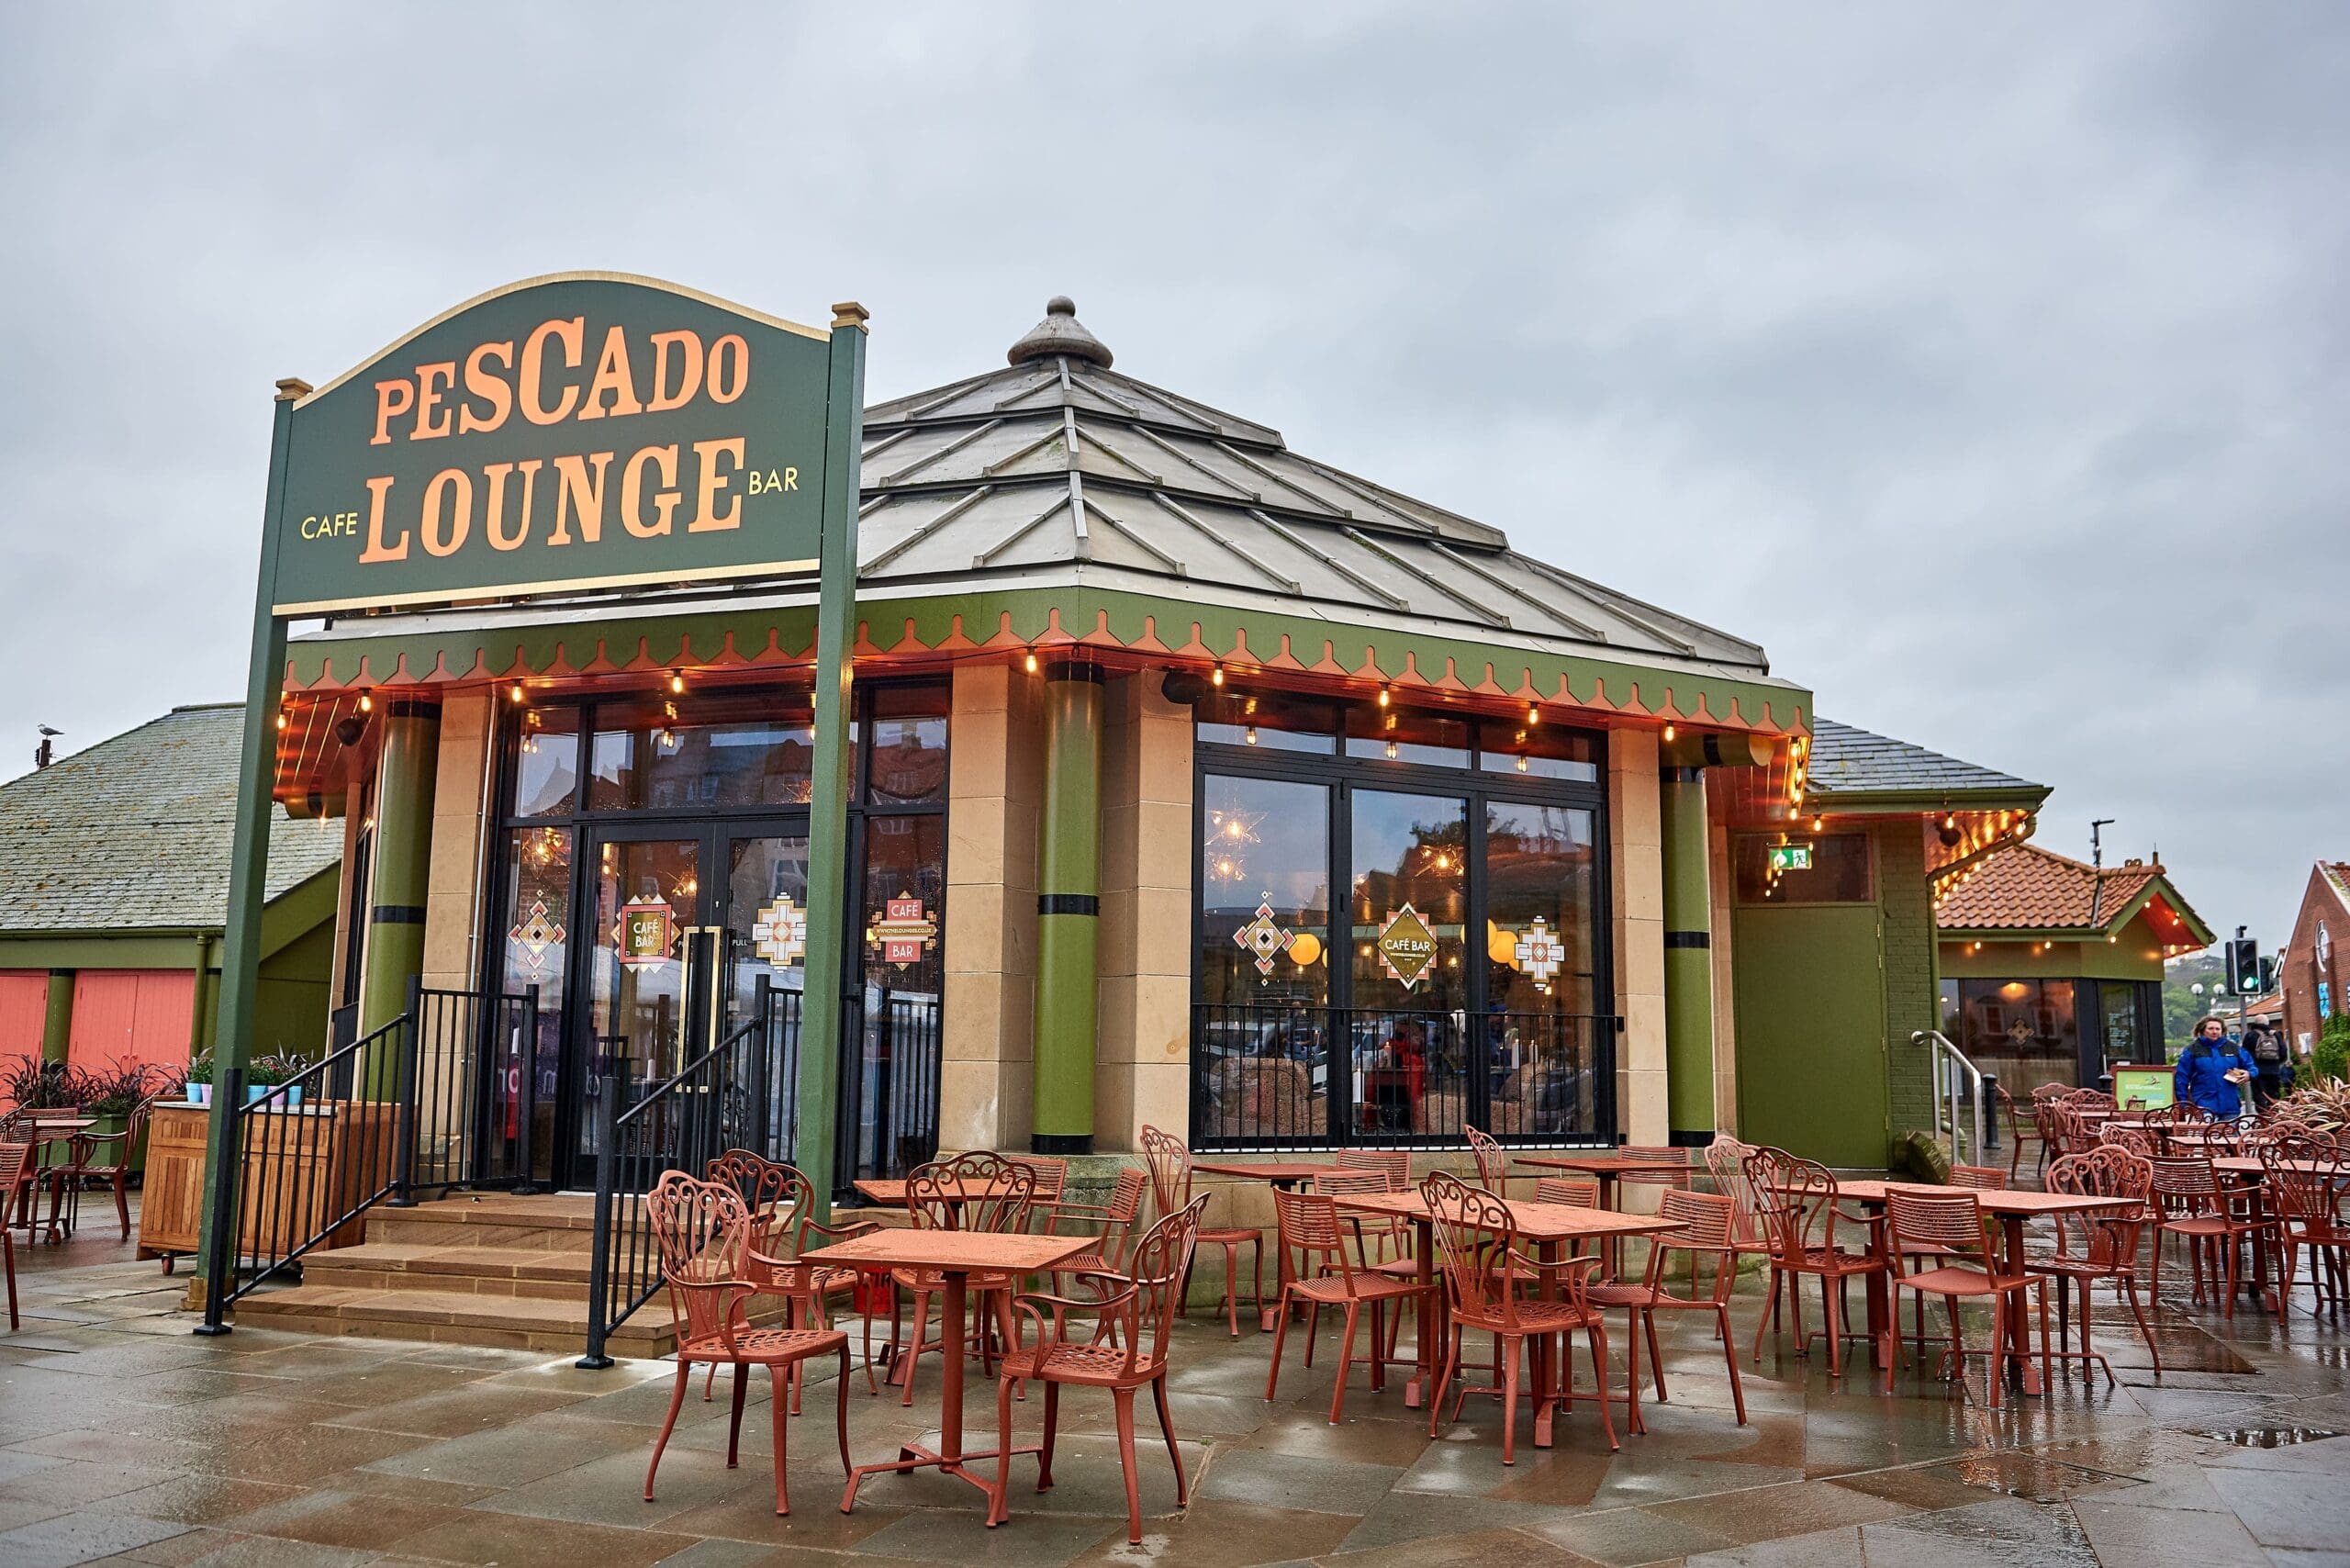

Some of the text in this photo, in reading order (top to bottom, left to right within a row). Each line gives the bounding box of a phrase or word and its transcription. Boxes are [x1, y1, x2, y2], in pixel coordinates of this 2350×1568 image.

[370, 317, 749, 445] PESCADO
[748, 467, 798, 495] BAR
[359, 437, 745, 564] LOUNGE
[301, 513, 357, 540] CAFE
[891, 902, 918, 917] CAFÉ
[633, 919, 659, 934] CAFÉ
[635, 936, 655, 947] BAR
[1385, 938, 1430, 952] CAFÉ BAR
[893, 946, 913, 958] BAR
